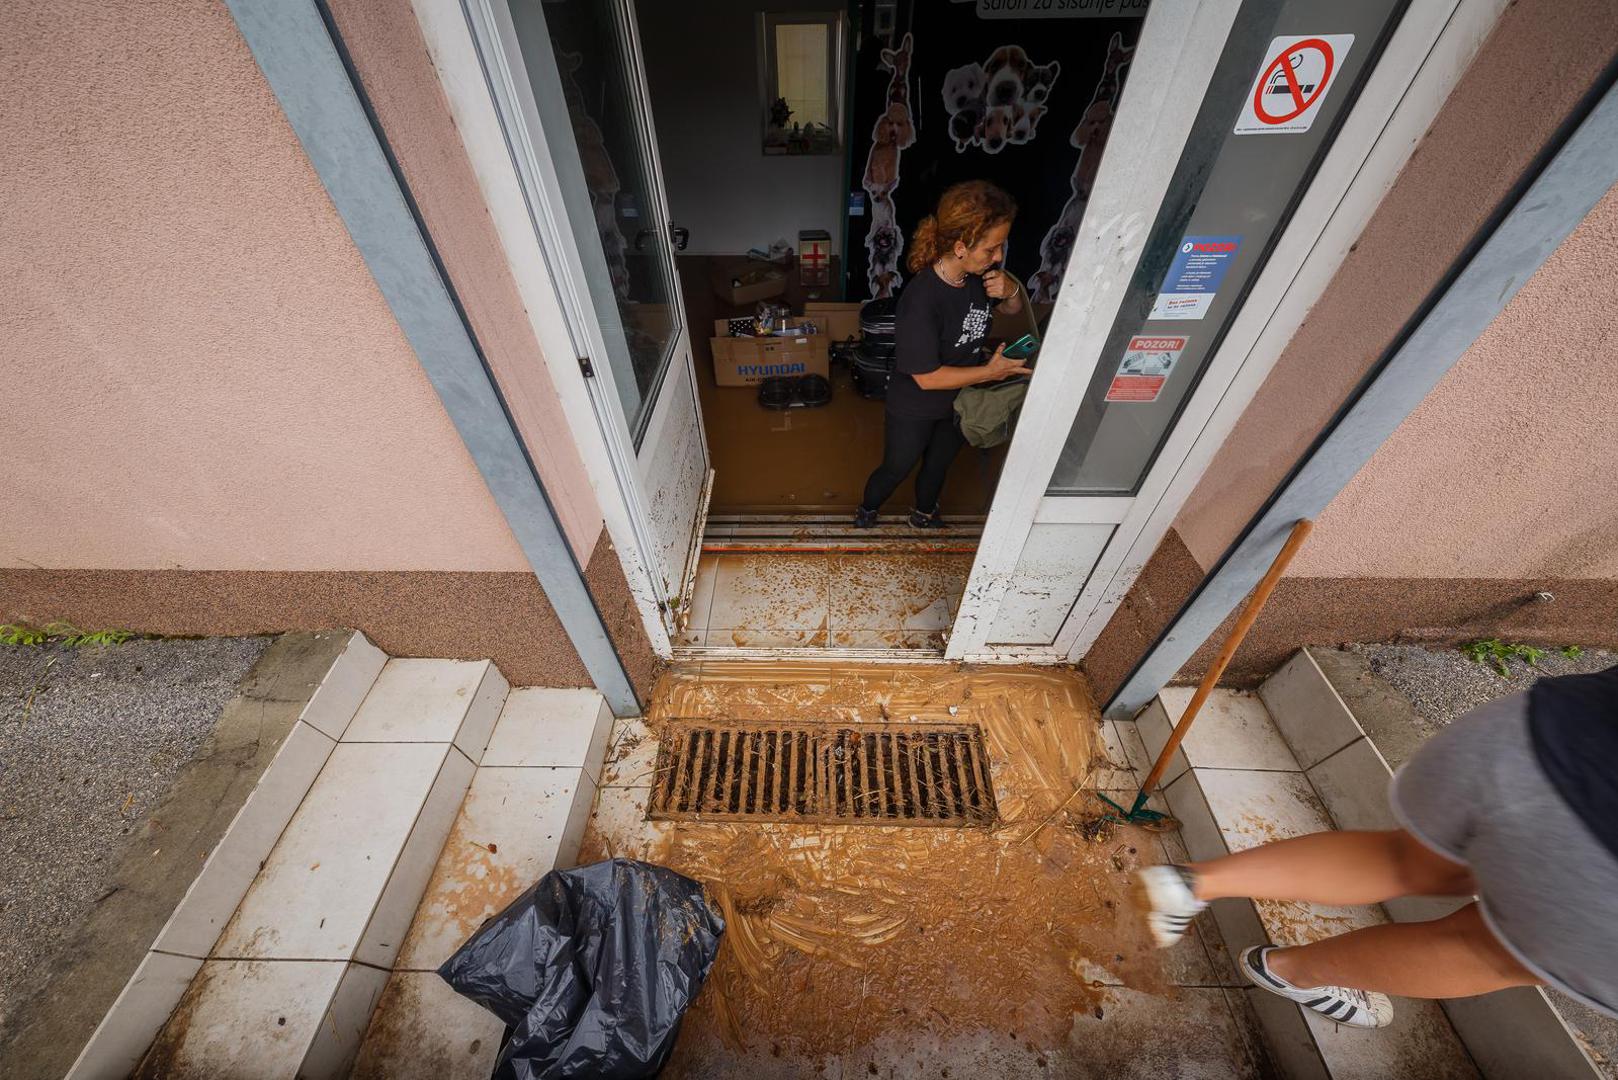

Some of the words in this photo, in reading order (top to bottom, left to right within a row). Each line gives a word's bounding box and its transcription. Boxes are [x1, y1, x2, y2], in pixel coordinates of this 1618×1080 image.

[1033, 0, 1053, 10] za
[1134, 340, 1180, 349] POZOR!
[736, 363, 806, 376] HYUNDAI
